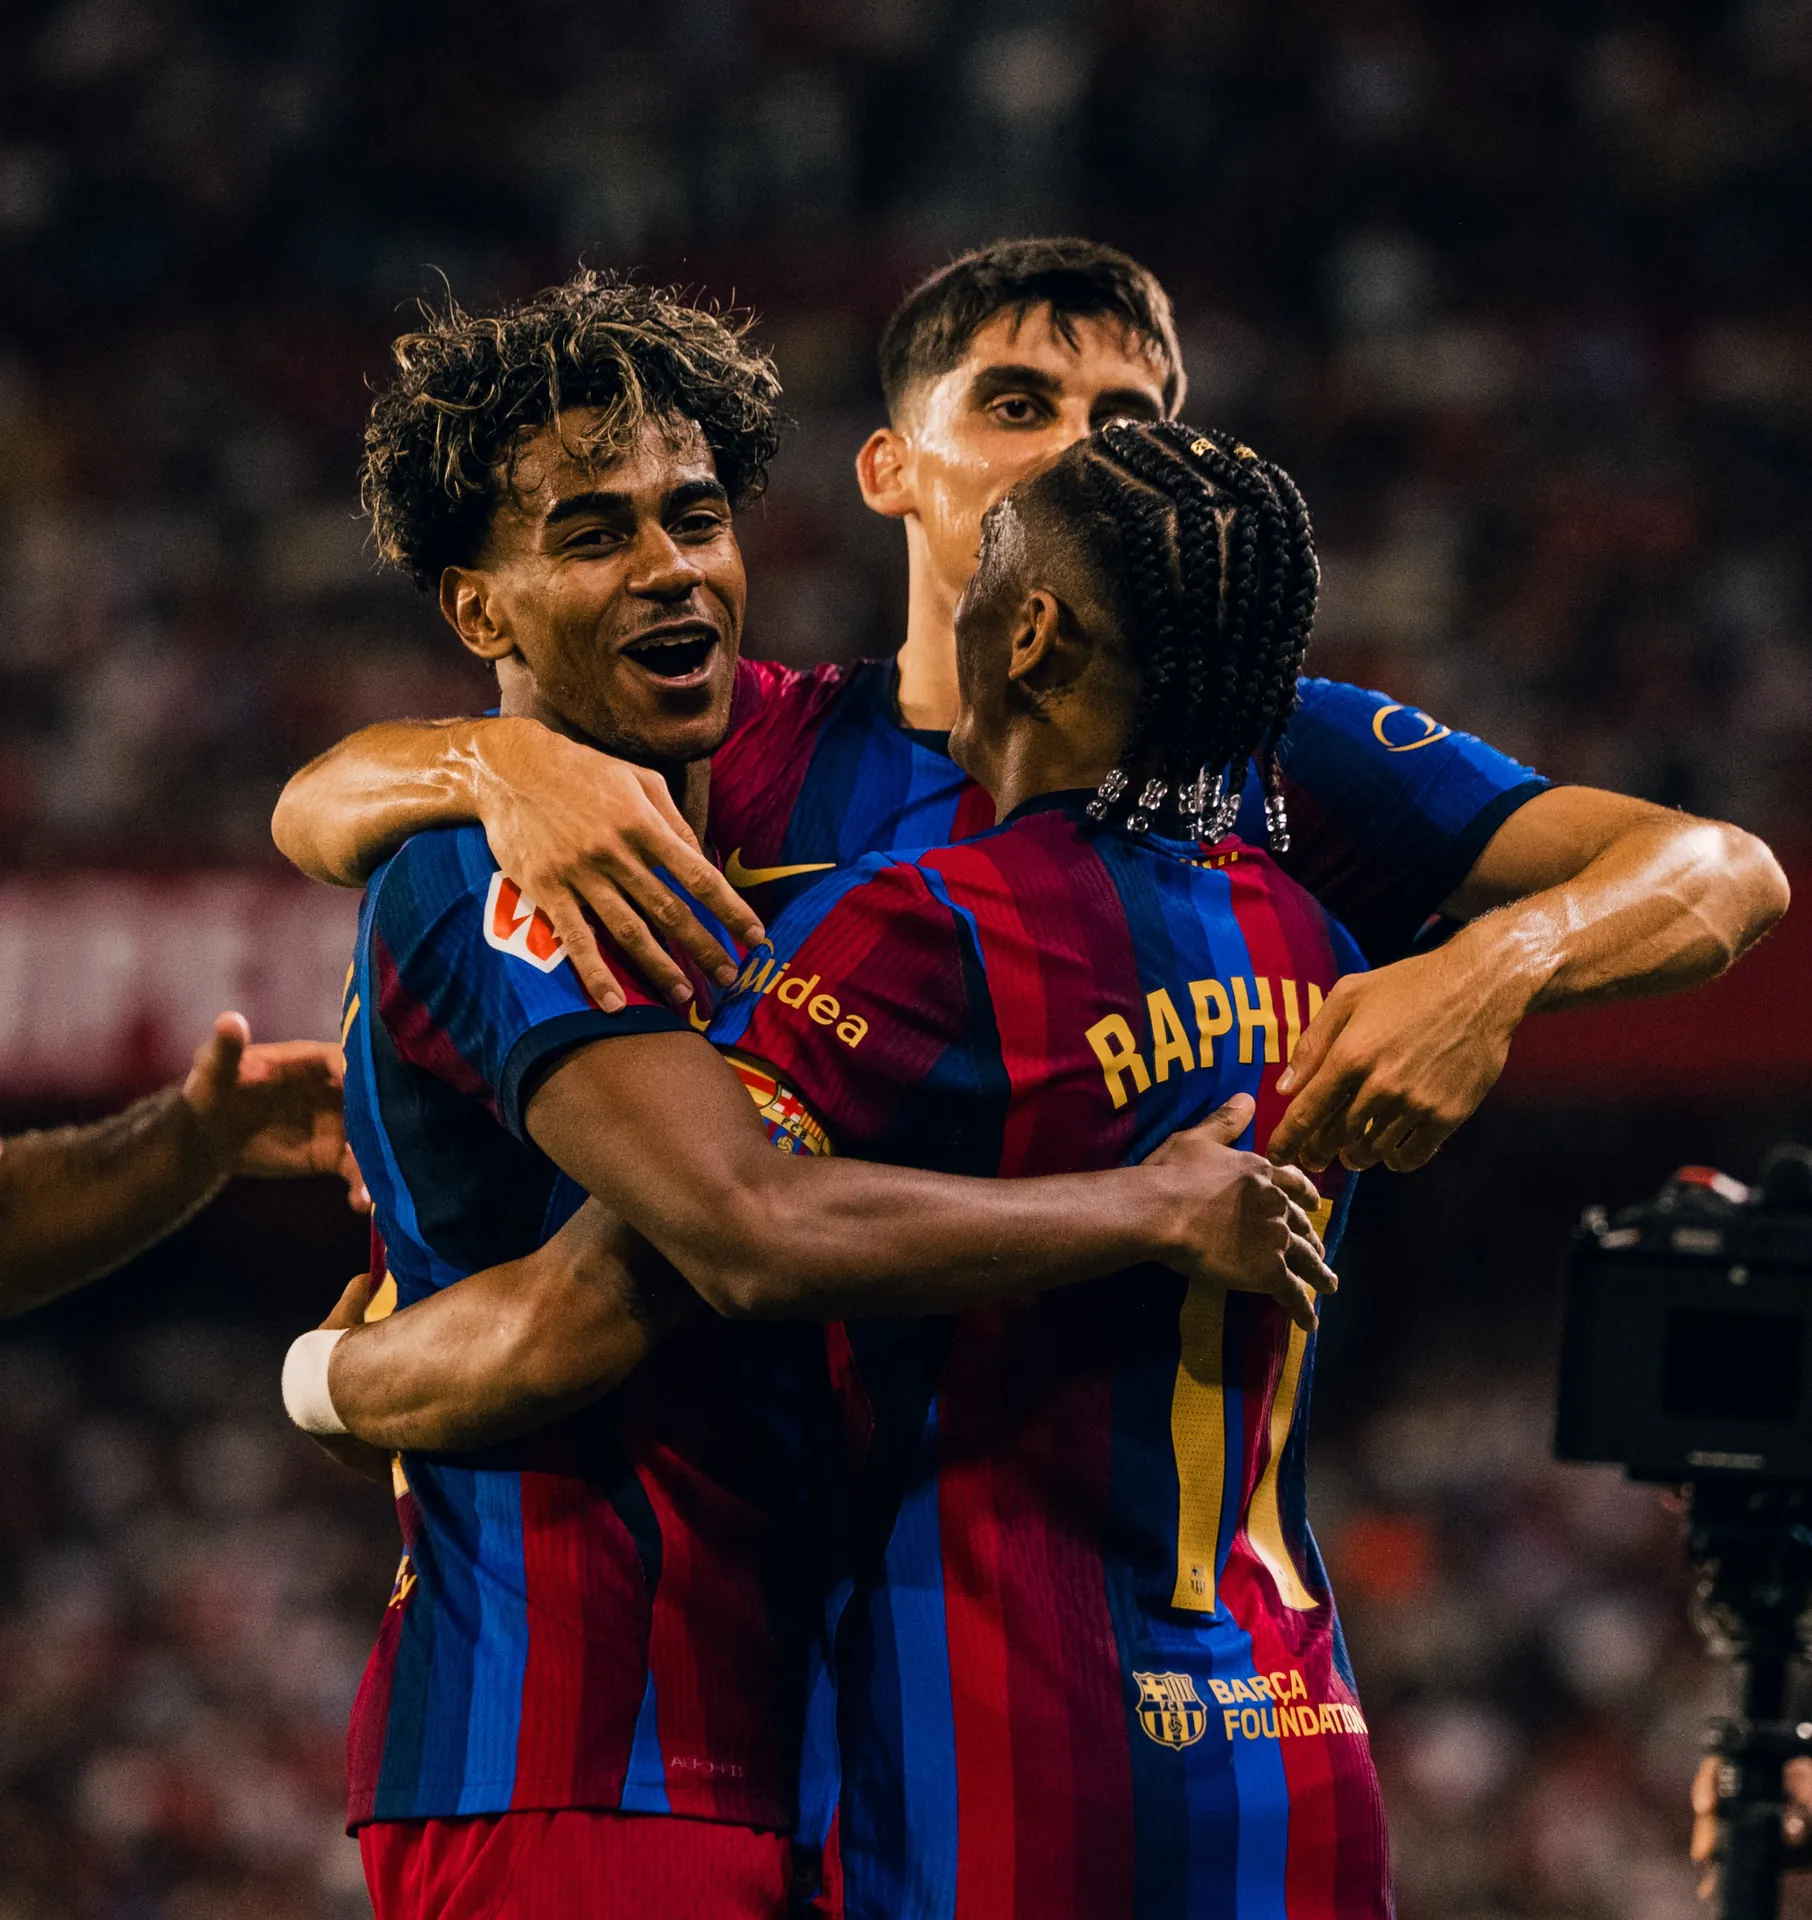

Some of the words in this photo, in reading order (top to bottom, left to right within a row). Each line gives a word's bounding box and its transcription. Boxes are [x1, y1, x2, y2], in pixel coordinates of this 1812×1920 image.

[728, 957, 869, 1048] Midea
[1084, 976, 1326, 1110] RAPHI
[1207, 1669, 1308, 1706] BARÇA
[1222, 1703, 1369, 1741] FOUNDATION
